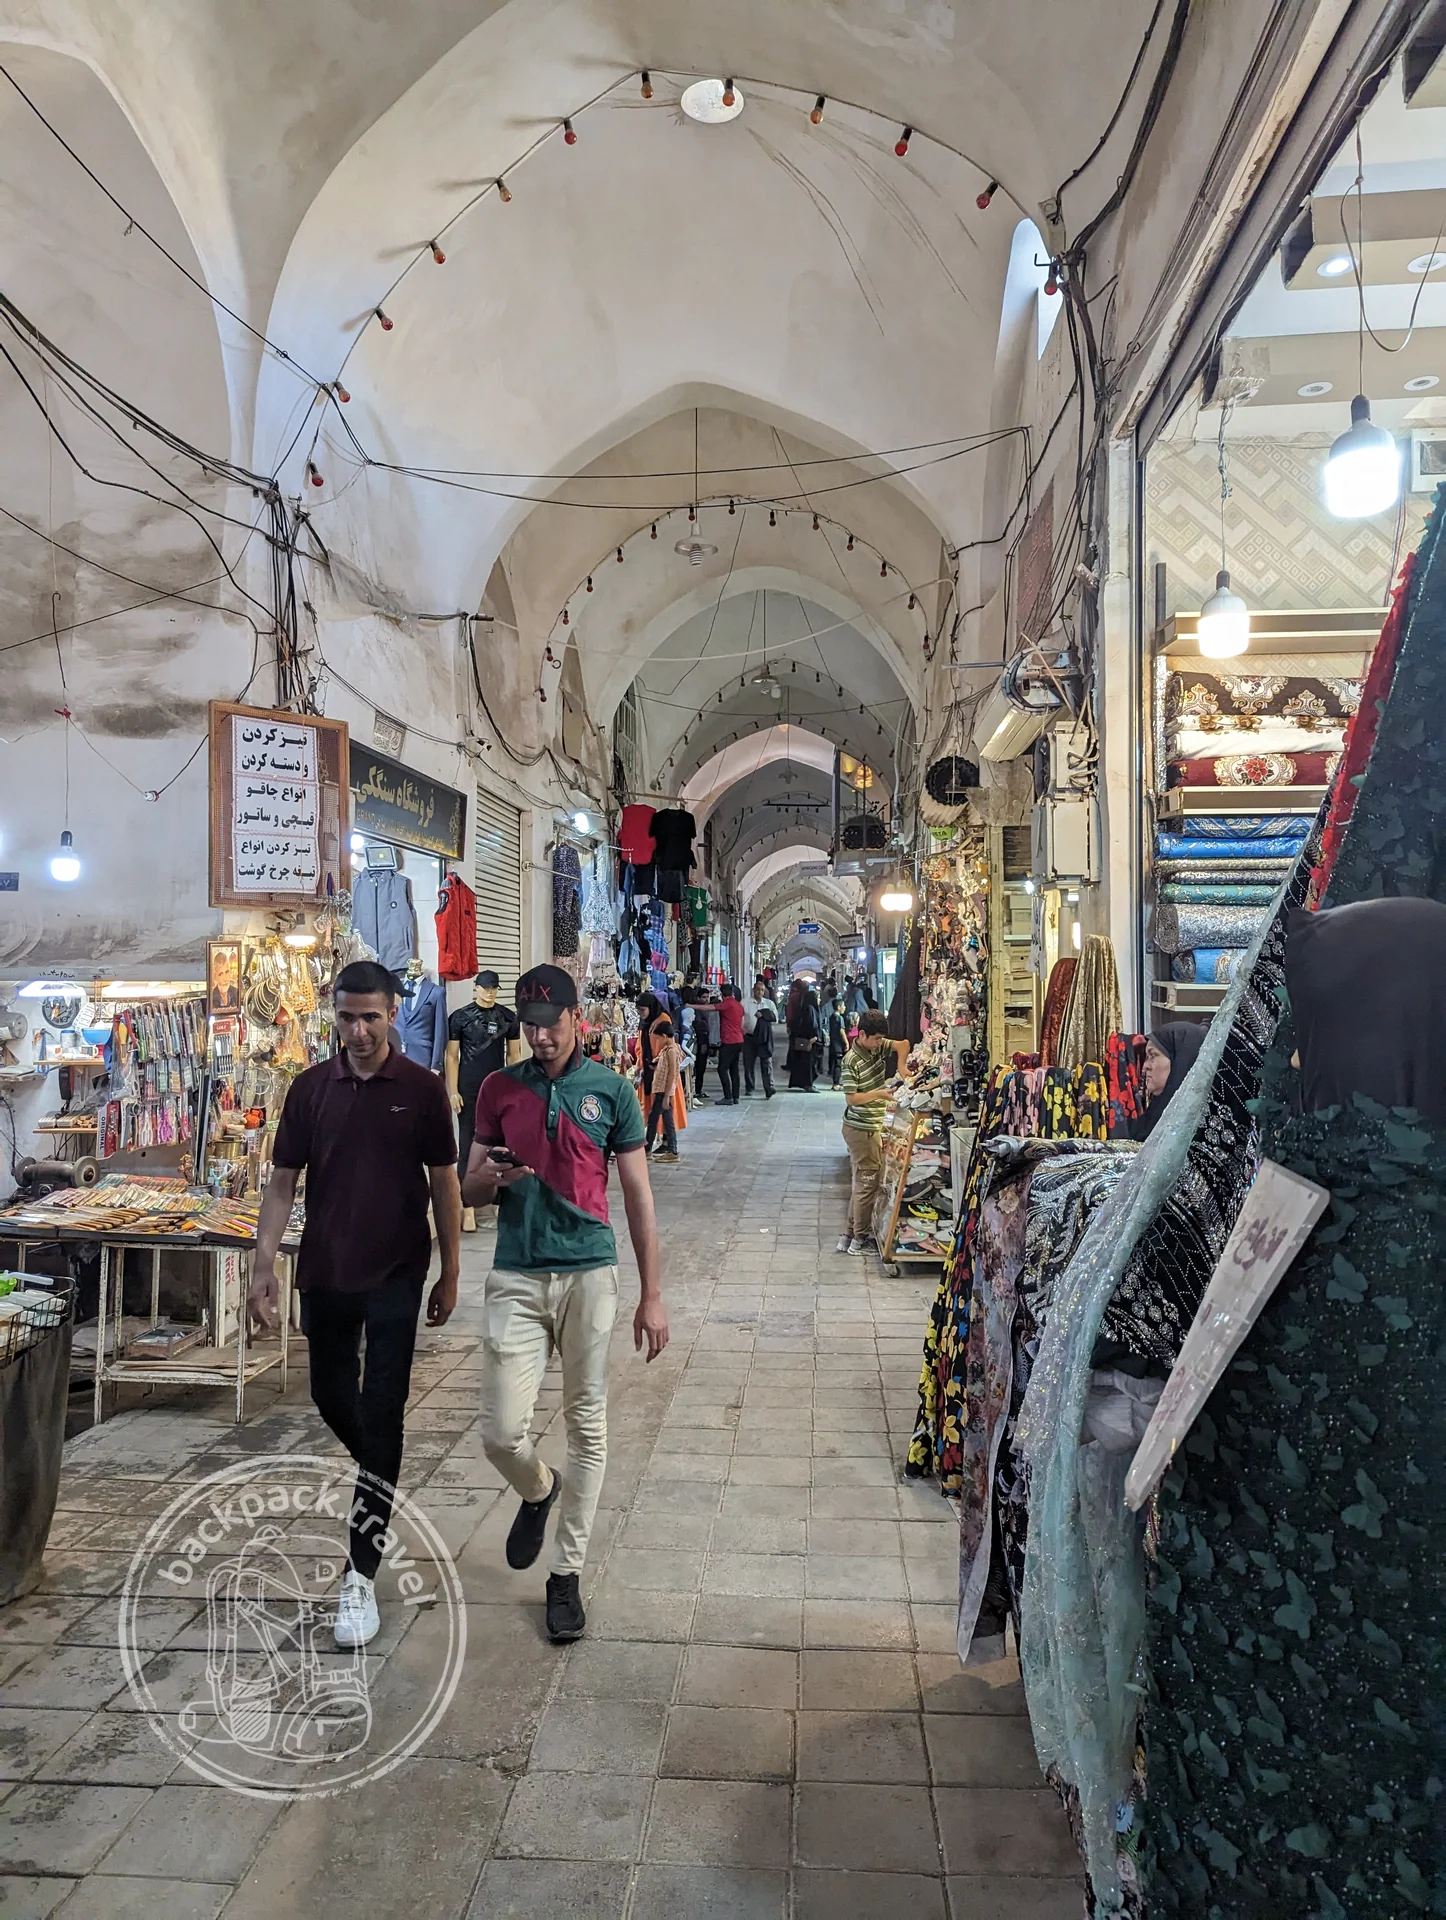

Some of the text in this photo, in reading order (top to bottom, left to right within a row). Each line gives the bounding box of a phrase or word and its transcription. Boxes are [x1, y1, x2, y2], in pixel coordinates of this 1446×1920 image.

[242, 728, 307, 749] تیز کردن
[241, 753, 309, 777] و دسته کردن
[246, 782, 306, 802] انواع چاقو
[396, 778, 435, 828] فروشگاه
[237, 807, 315, 830] قیچی و ساتور
[241, 840, 311, 856] تیز کردن انواع
[238, 862, 316, 881] تیغه چرخ گوشت
